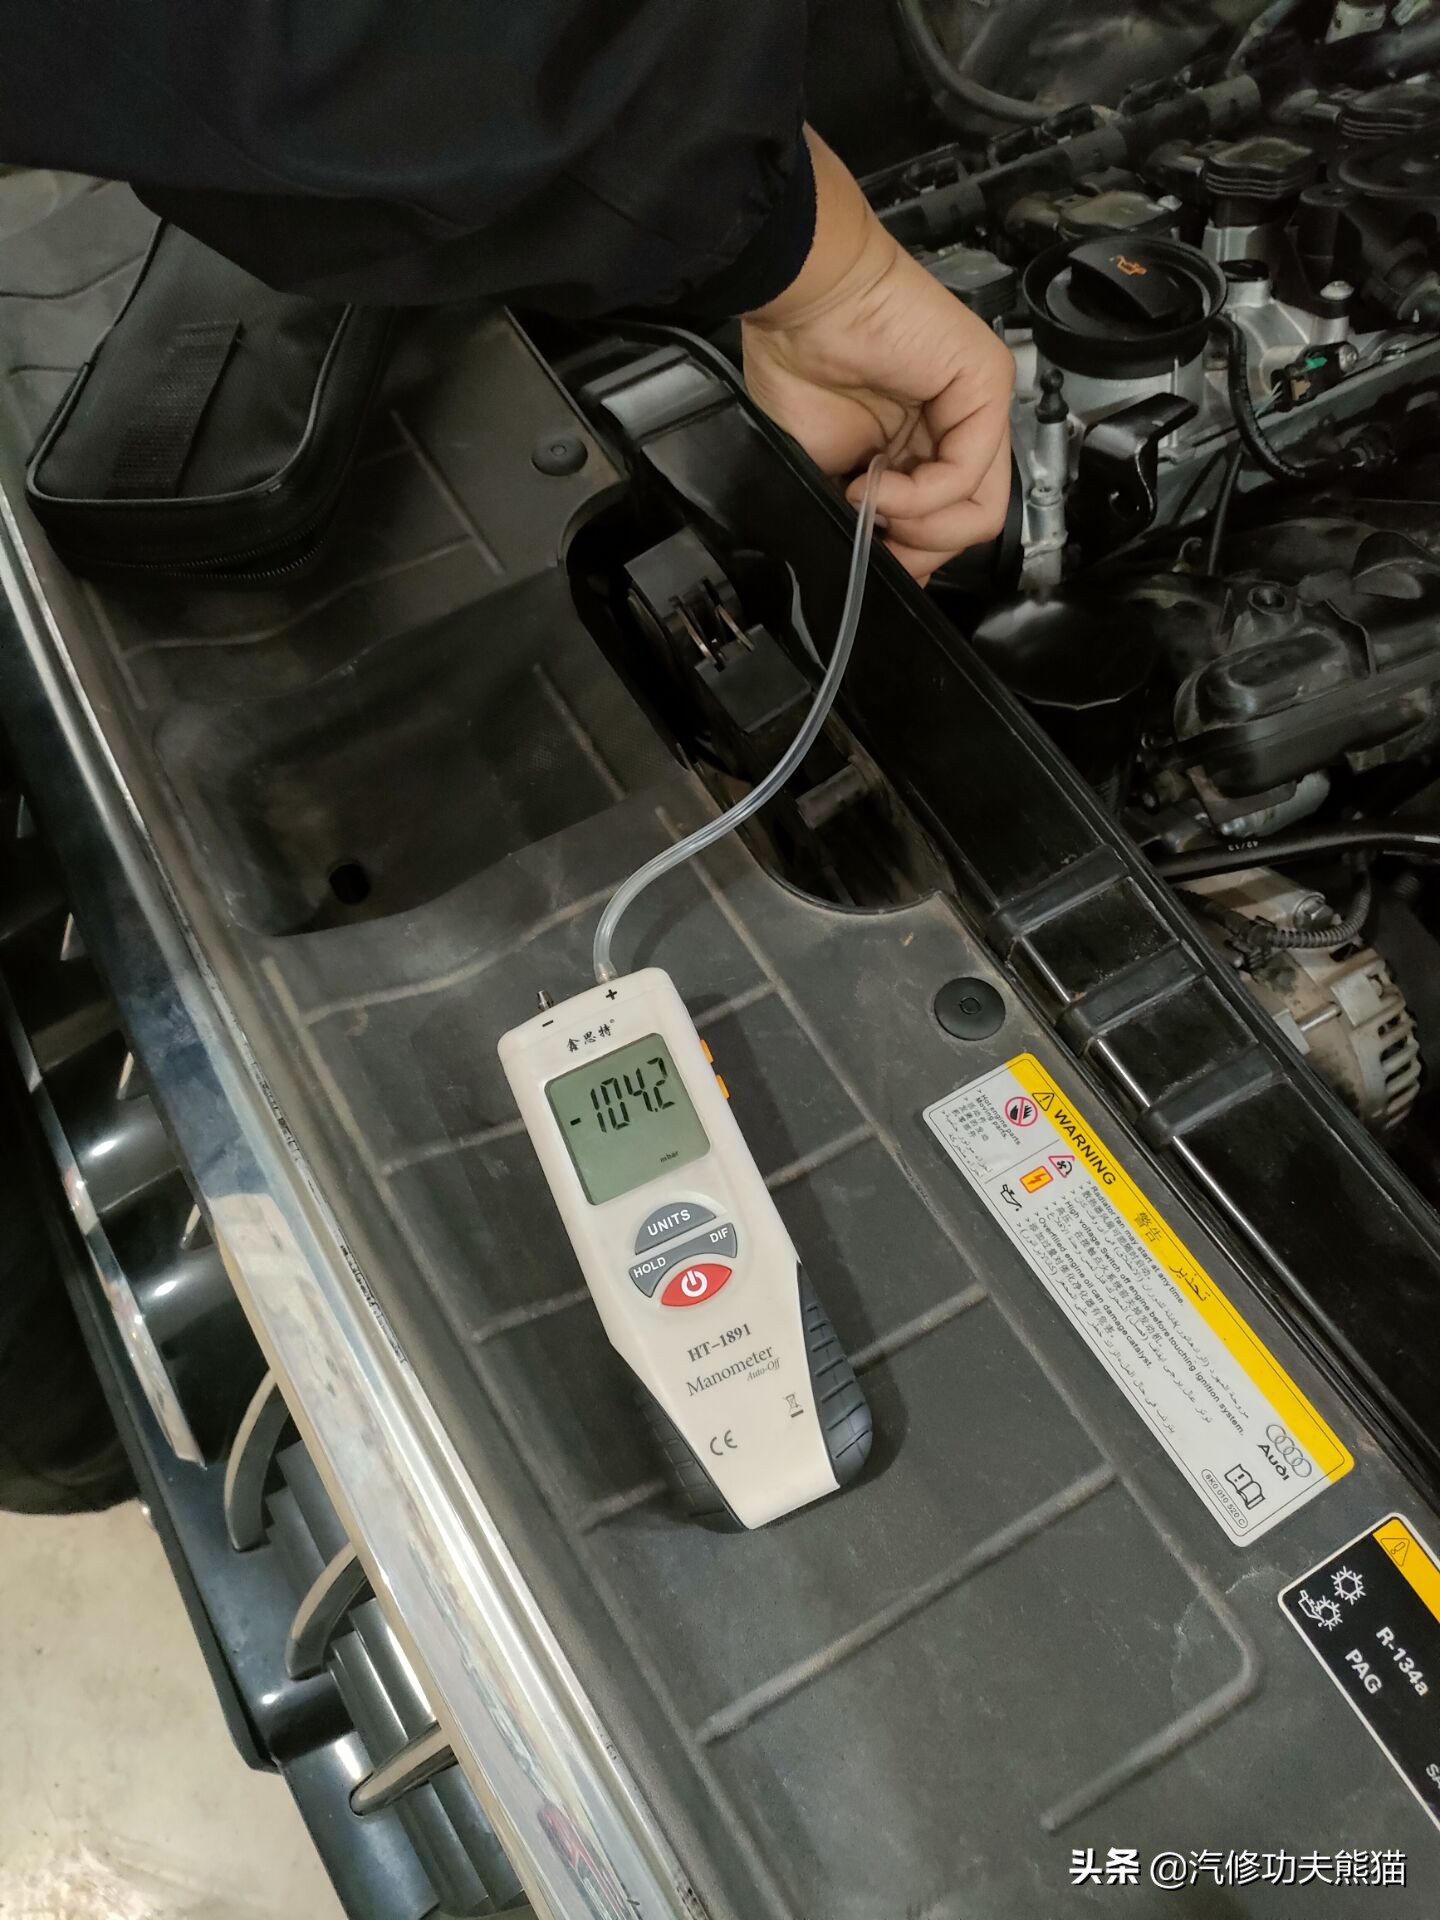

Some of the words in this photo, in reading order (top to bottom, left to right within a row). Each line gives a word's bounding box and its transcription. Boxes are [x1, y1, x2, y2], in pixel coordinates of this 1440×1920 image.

[569, 1056, 676, 1133] -104.2
[974, 1096, 995, 1121] Moving
[980, 1093, 991, 1106] Hot
[988, 1106, 1008, 1130] engine
[1005, 1127, 1021, 1146] parts
[1052, 1108, 1116, 1186] WARNING
[647, 1209, 691, 1236] UNITS
[709, 1227, 729, 1243] DIF
[1090, 1184, 1116, 1216] Radiator
[1113, 1215, 1126, 1229] fan
[1122, 1228, 1138, 1246] may
[1136, 1244, 1153, 1264] start
[1150, 1262, 1160, 1273] at
[1156, 1272, 1170, 1288] any
[1168, 1286, 1186, 1306] time.
[1132, 1209, 1164, 1245] 警告
[633, 1257, 666, 1278] HOLD
[1036, 1215, 1068, 1253] Overfilled
[1062, 1251, 1086, 1279] engine
[1082, 1277, 1094, 1289] oil
[1090, 1288, 1104, 1304] can
[1101, 1302, 1130, 1337] damage
[1167, 1254, 1212, 1305] تحذير
[1063, 1199, 1081, 1219] High
[1099, 1246, 1122, 1273] Switch
[1118, 1271, 1131, 1285] off
[1127, 1283, 1151, 1312] engine
[1148, 1310, 1172, 1338] before
[1166, 1335, 1198, 1373] touching
[1193, 1370, 1222, 1403] ignition
[687, 1323, 752, 1362] HT-1891
[686, 1346, 774, 1397] Manometer
[747, 1358, 781, 1381] Auto-Off
[1256, 1439, 1292, 1481] Audi
[1204, 1473, 1219, 1490] 8K0
[1215, 1488, 1229, 1504] 010
[1226, 1503, 1240, 1519] 520
[1237, 1517, 1246, 1527] C
[1345, 1648, 1383, 1695] PAG
[1375, 1626, 1430, 1697] R-134a
